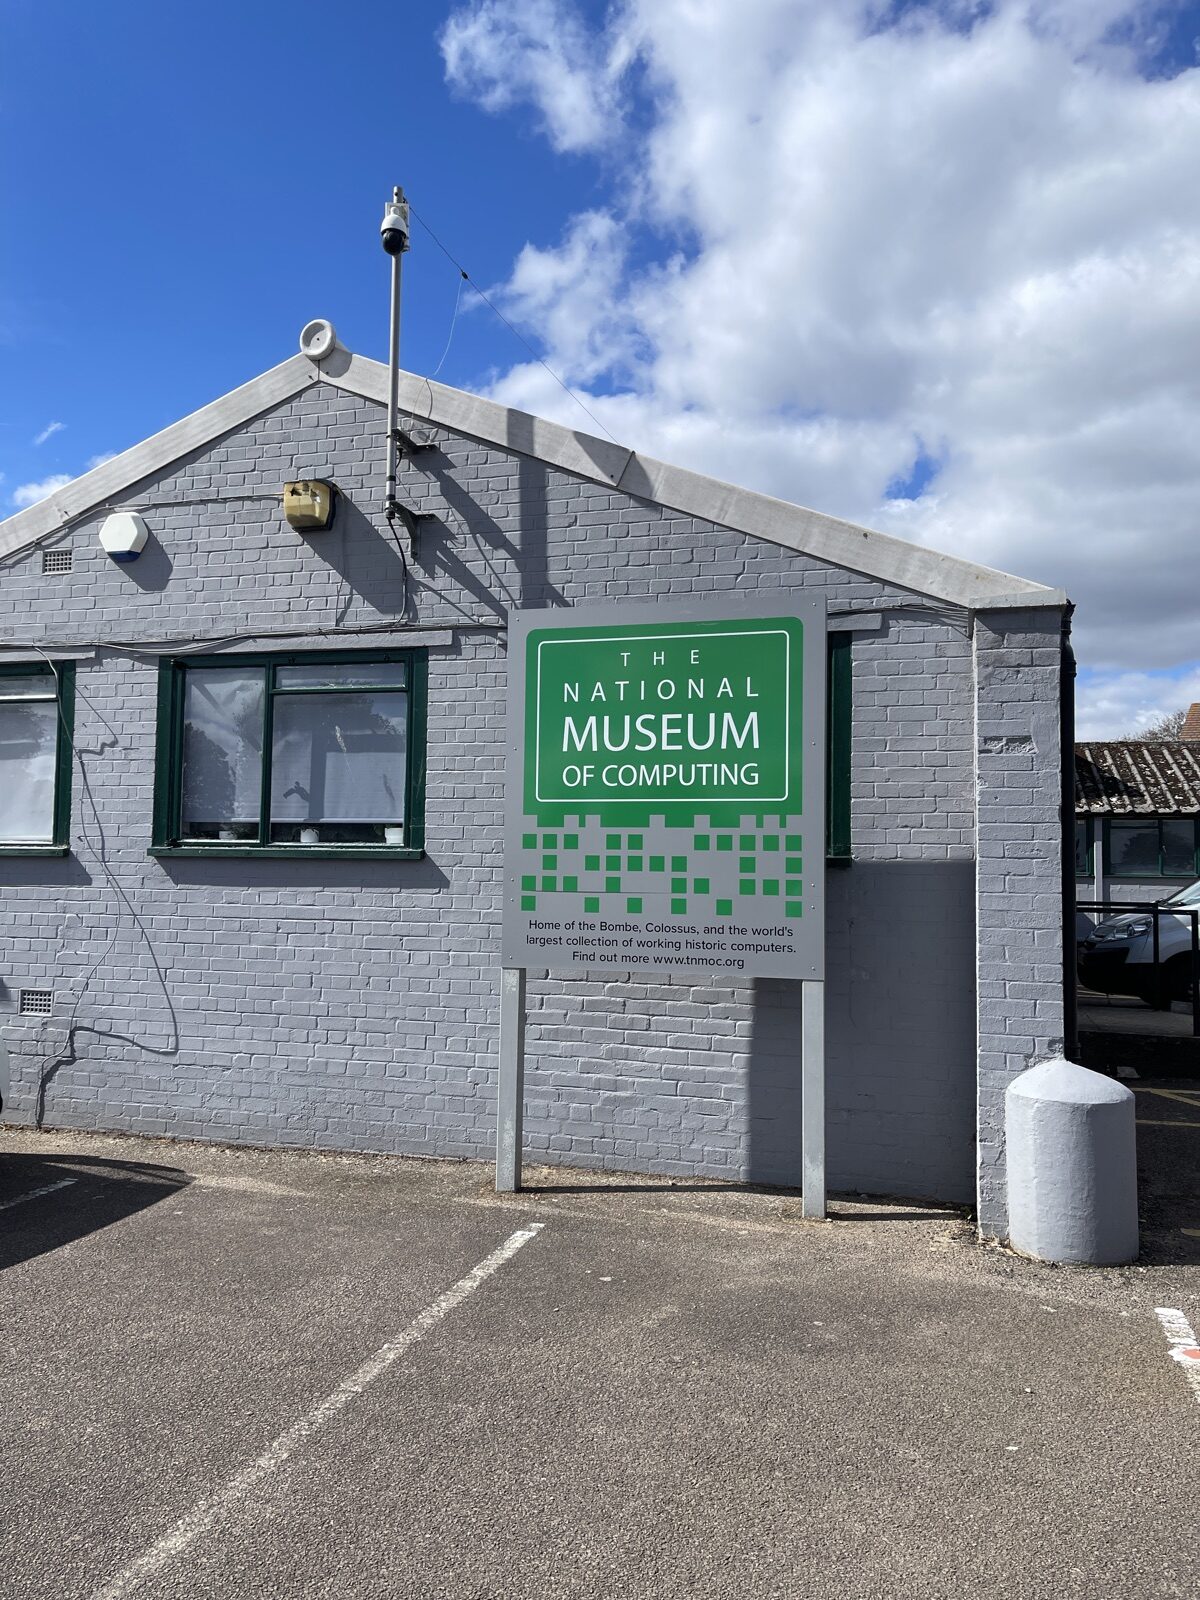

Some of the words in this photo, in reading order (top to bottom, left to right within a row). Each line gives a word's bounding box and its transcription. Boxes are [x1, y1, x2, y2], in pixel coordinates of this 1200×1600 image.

[621, 650, 699, 667] THE
[563, 676, 759, 702] NATIONAL
[562, 711, 760, 752] MUSEUM
[562, 765, 595, 787] OF
[602, 763, 759, 786] COMPUTING
[529, 920, 561, 931] Home
[564, 920, 575, 931] of
[578, 920, 596, 932] the
[600, 921, 642, 934] Bombe,
[645, 922, 699, 935] Colossus,
[703, 924, 725, 936] and
[728, 925, 748, 936] the
[751, 926, 793, 937] world's
[526, 935, 563, 948] largest
[566, 936, 618, 948] collection
[622, 937, 633, 948] of
[636, 938, 681, 952] working
[685, 939, 727, 951] historic
[730, 942, 796, 955] computers.
[572, 951, 596, 962] Find
[599, 952, 618, 963] out
[621, 954, 650, 964] more
[653, 955, 745, 970] www.tnmoc.org
